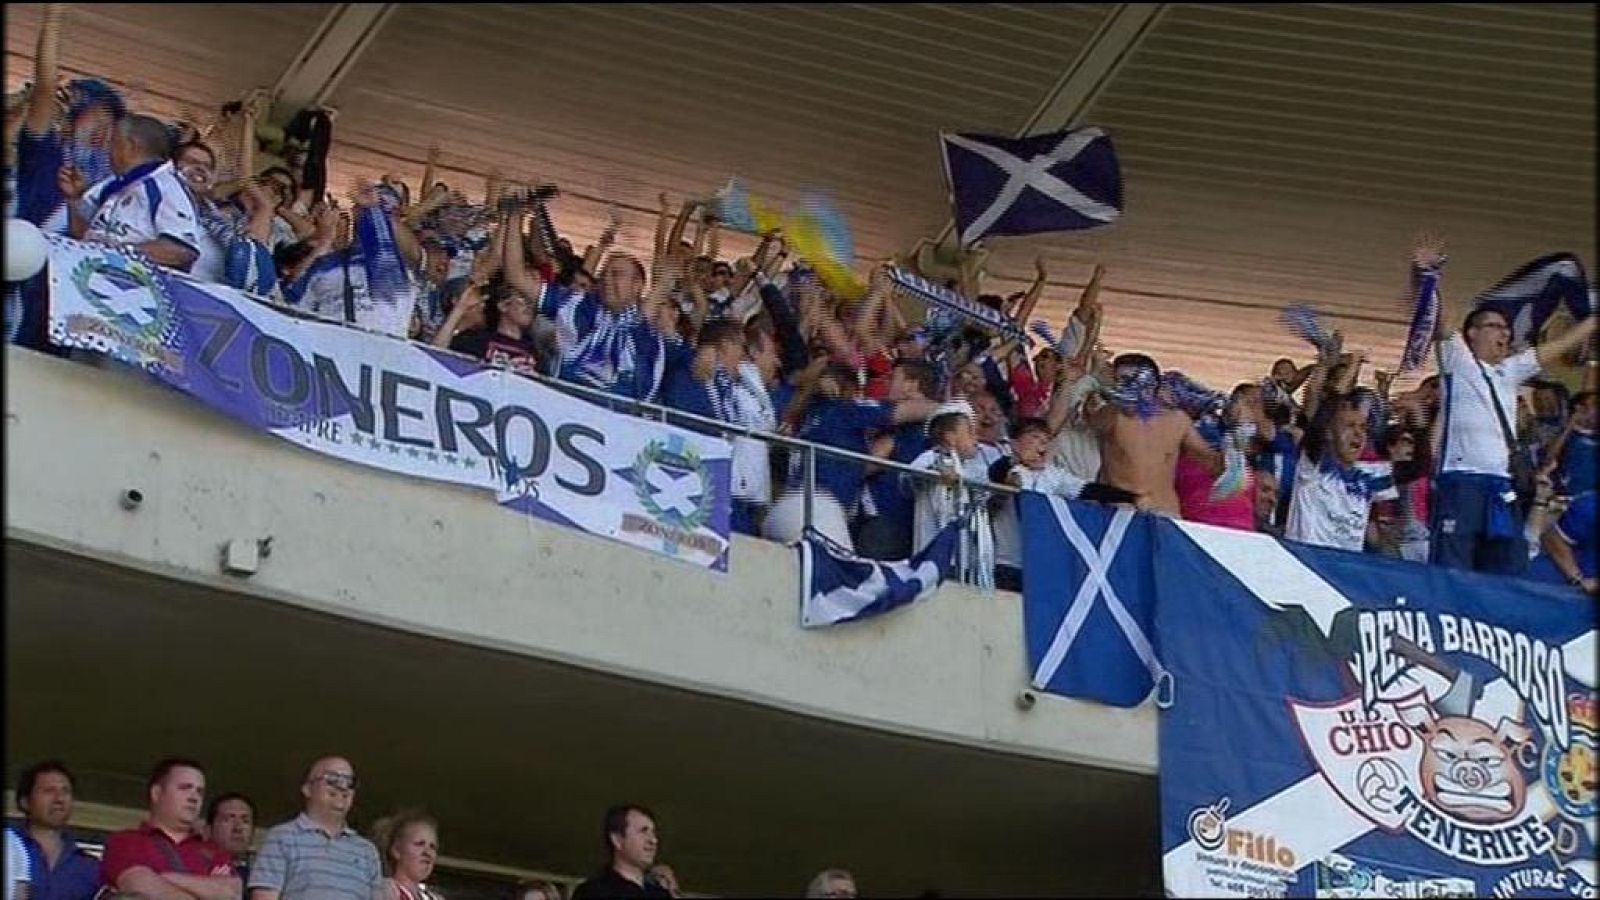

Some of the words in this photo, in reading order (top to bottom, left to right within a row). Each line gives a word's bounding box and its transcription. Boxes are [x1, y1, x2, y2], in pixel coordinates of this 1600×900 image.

[188, 306, 606, 497] ZONEROS
[1438, 613, 1570, 746] BARROSO
[1328, 721, 1413, 756] CHIO
[1227, 829, 1296, 868] Fillo
[1392, 785, 1553, 862] TENERIFE
